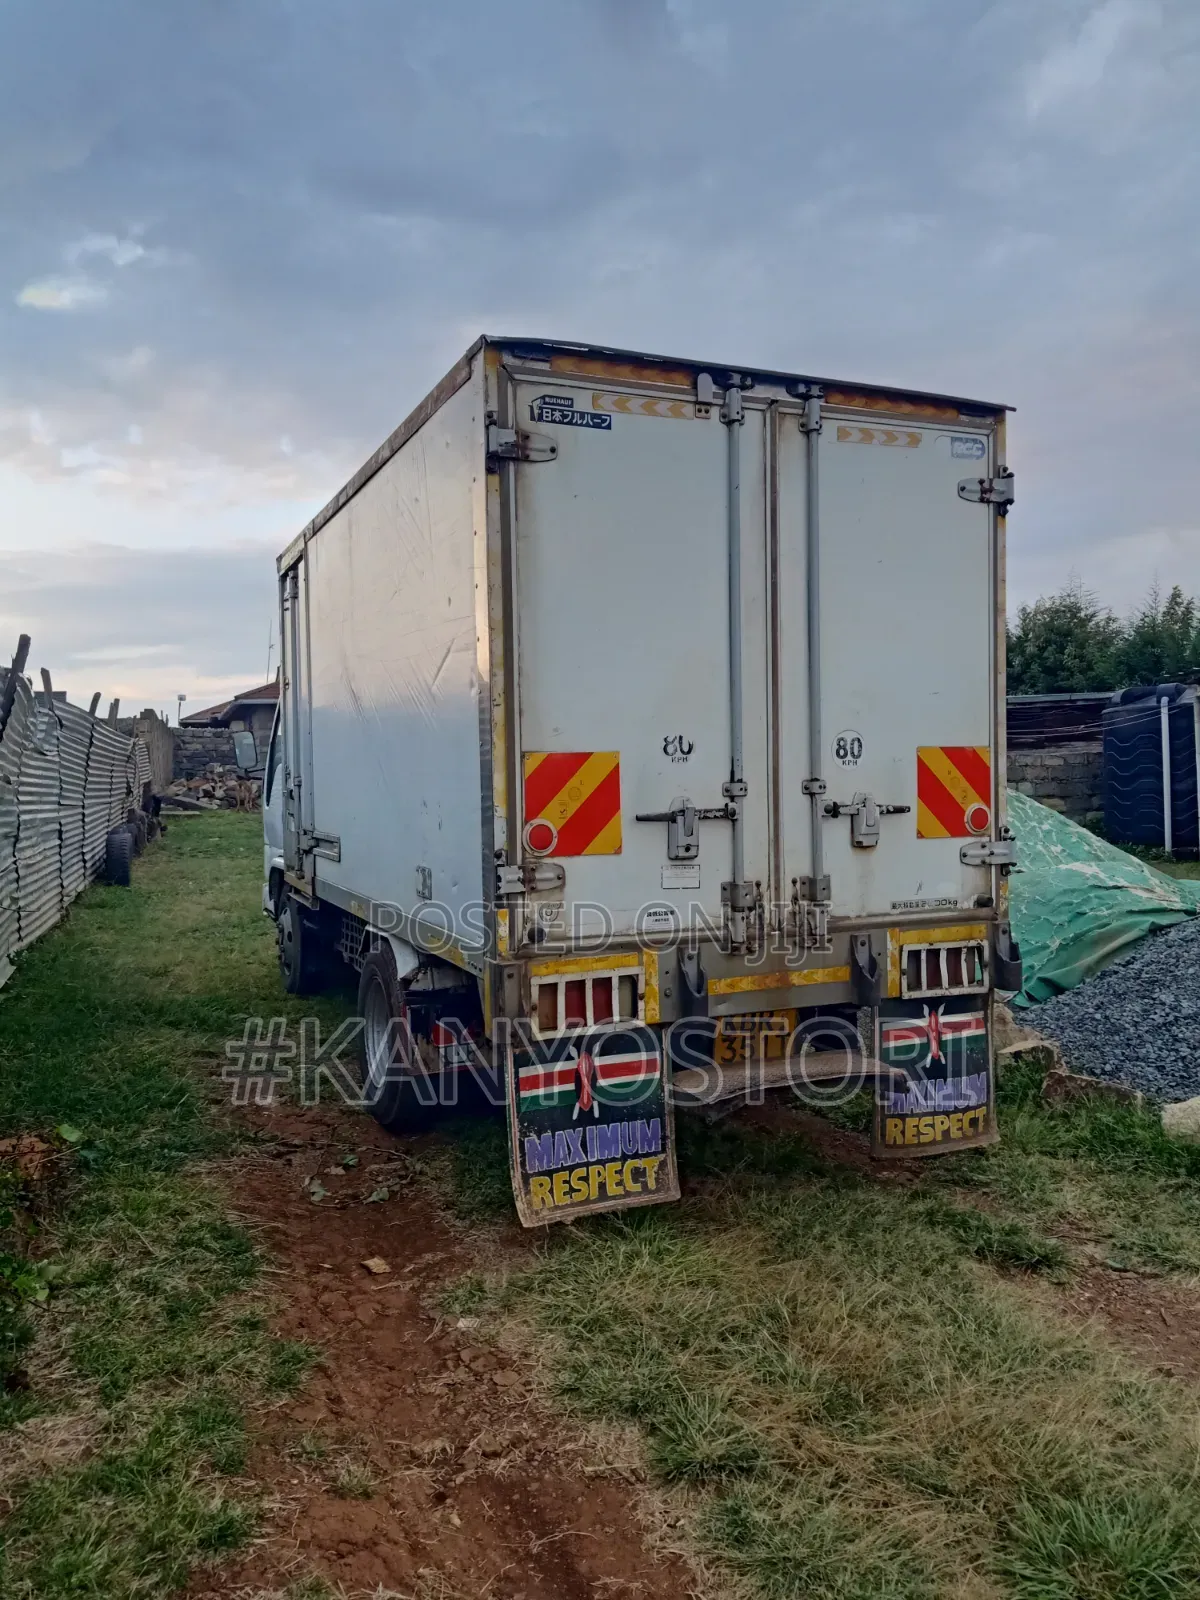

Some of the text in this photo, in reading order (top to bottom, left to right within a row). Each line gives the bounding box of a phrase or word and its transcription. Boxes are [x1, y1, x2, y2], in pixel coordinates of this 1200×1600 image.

[542, 408, 611, 427] 日本フルハーフ
[671, 755, 688, 763] KPH
[835, 736, 863, 760] 80
[884, 1071, 988, 1115] MAXIMUM
[885, 1106, 988, 1145] RESPECT
[524, 1118, 662, 1173] MAXIMUM
[529, 1155, 667, 1210] RESPECT
